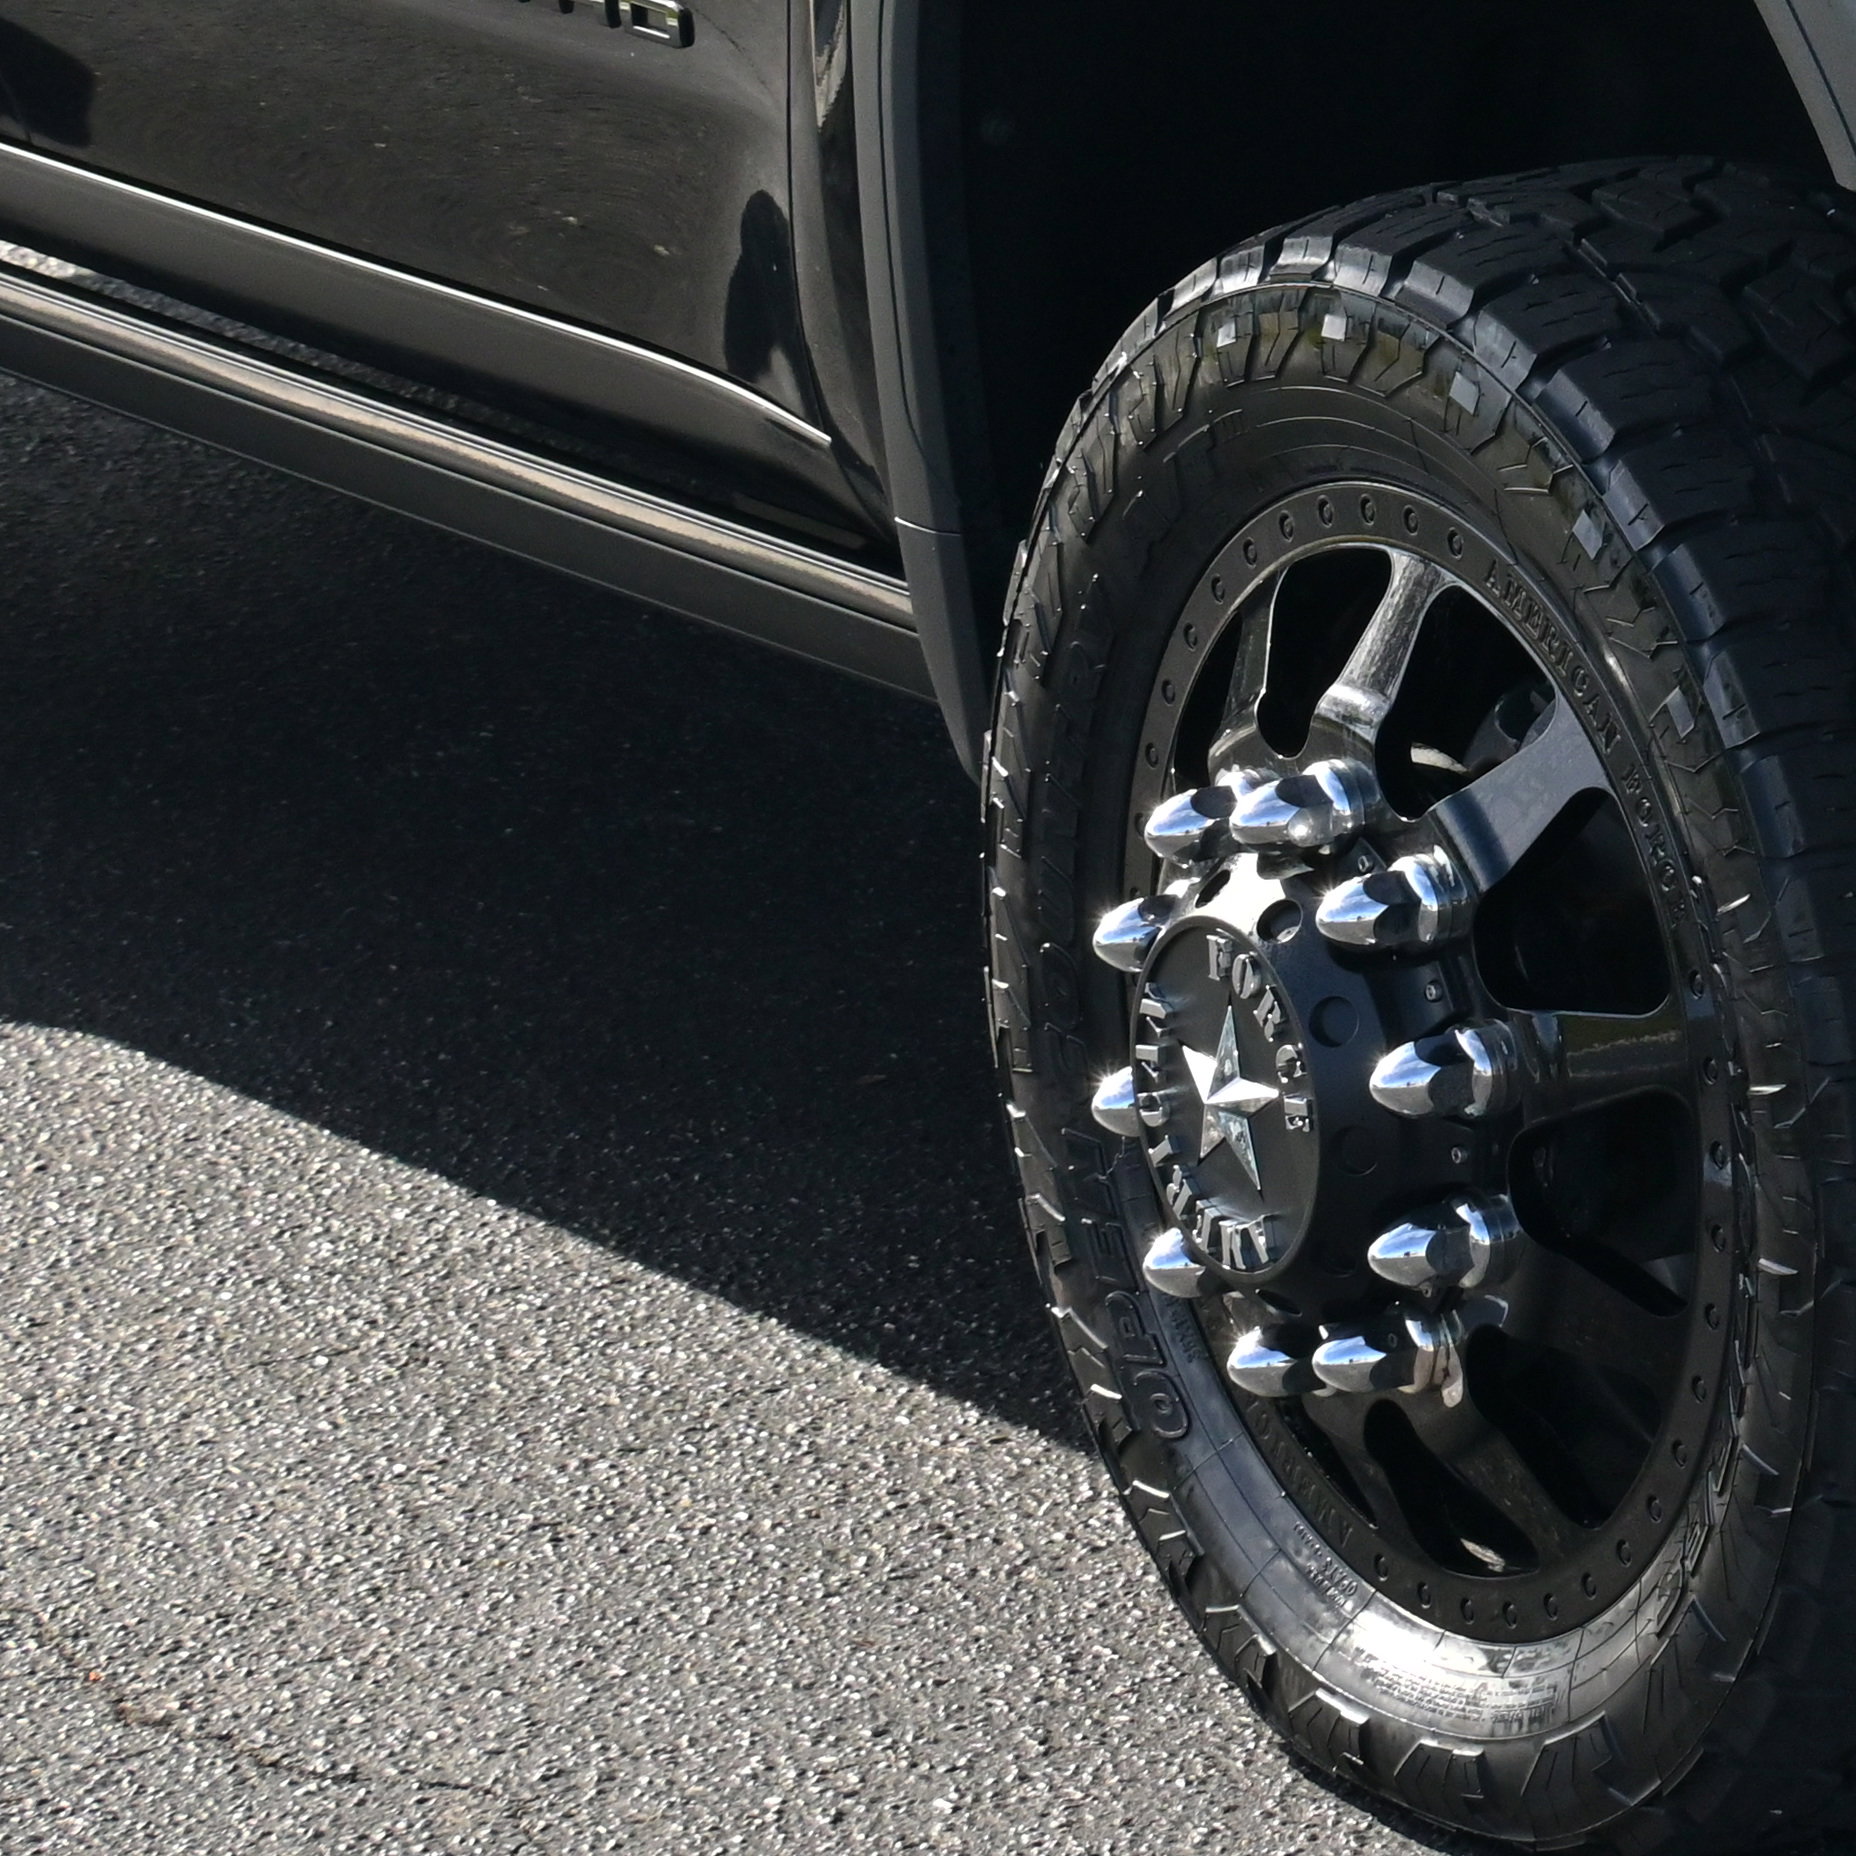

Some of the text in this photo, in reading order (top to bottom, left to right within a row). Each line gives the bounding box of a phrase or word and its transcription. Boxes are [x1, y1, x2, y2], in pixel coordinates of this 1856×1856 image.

[1483, 558, 1689, 931] AMERICAN FORCE
[1206, 934, 1313, 1133] FORCE
[1063, 1122, 1192, 1441] OPEN
